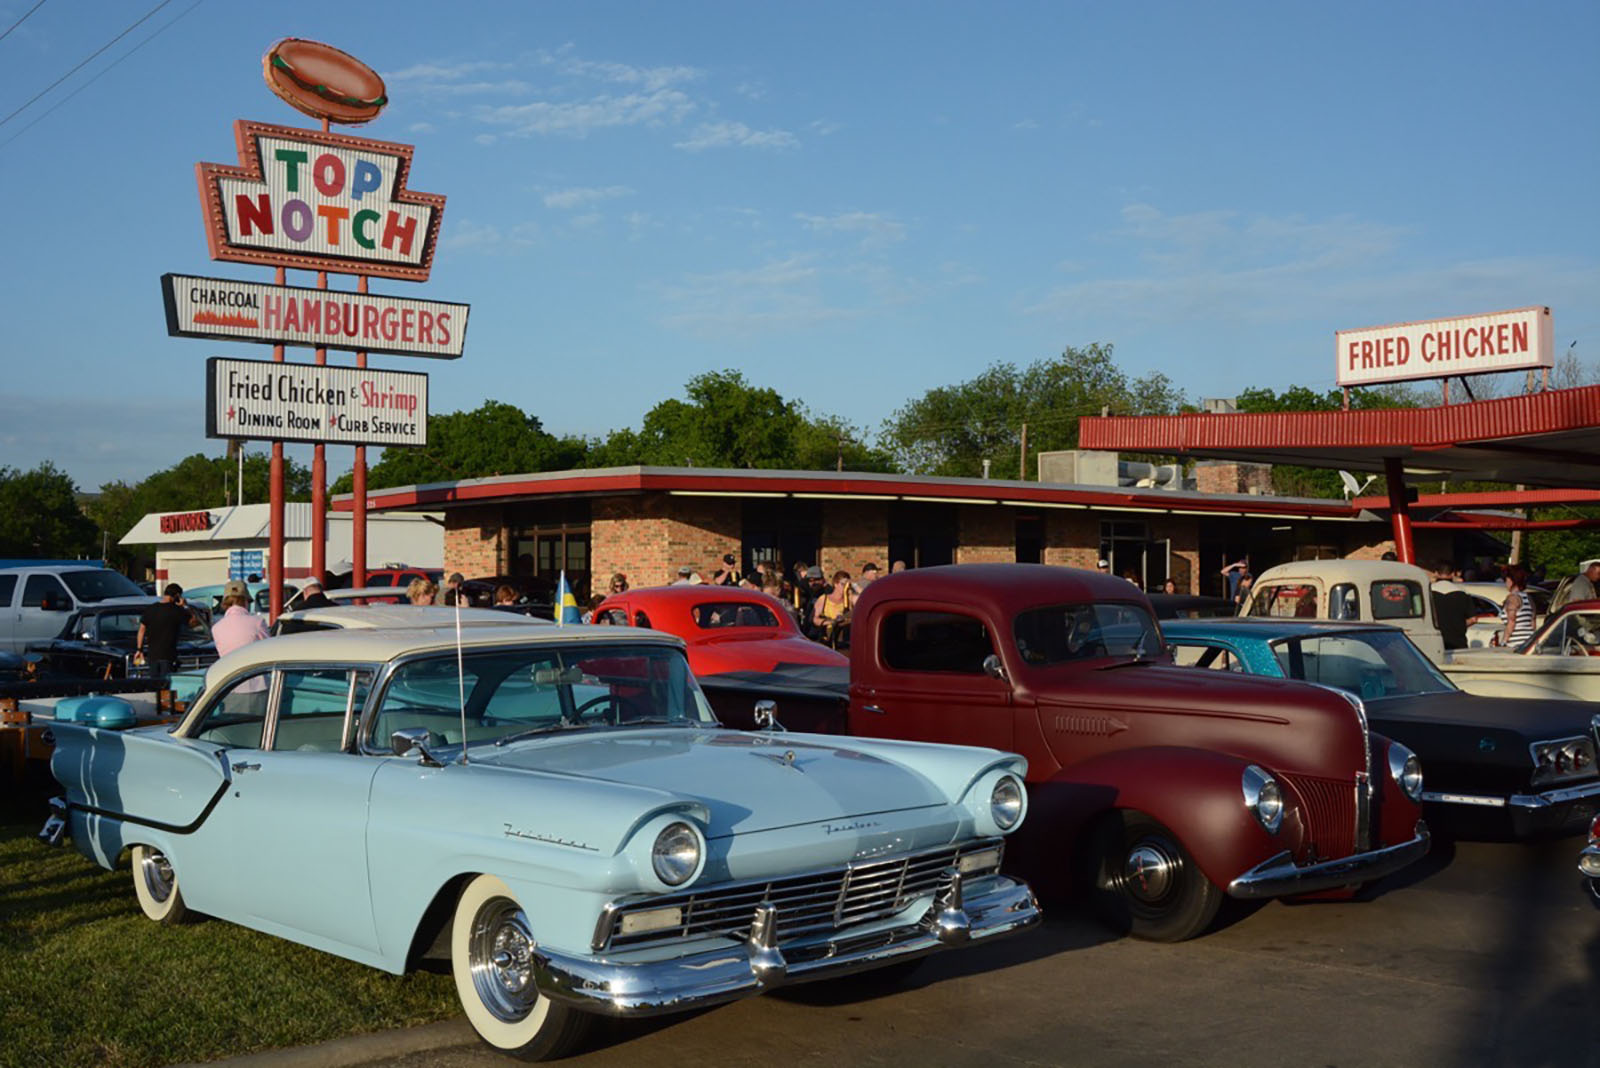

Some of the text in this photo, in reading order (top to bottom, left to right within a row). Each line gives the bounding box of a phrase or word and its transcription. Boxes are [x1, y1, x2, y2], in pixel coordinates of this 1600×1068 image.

[275, 149, 382, 200] TOP
[235, 193, 417, 256] NOTCH
[191, 287, 451, 346] CHARCOAL HAMBURGERS
[1349, 321, 1529, 371] FRIED CHICKEN
[229, 371, 417, 418] Fried Chicken & Shrimp
[239, 406, 416, 435] DINING ROOM CURB SERVICE
